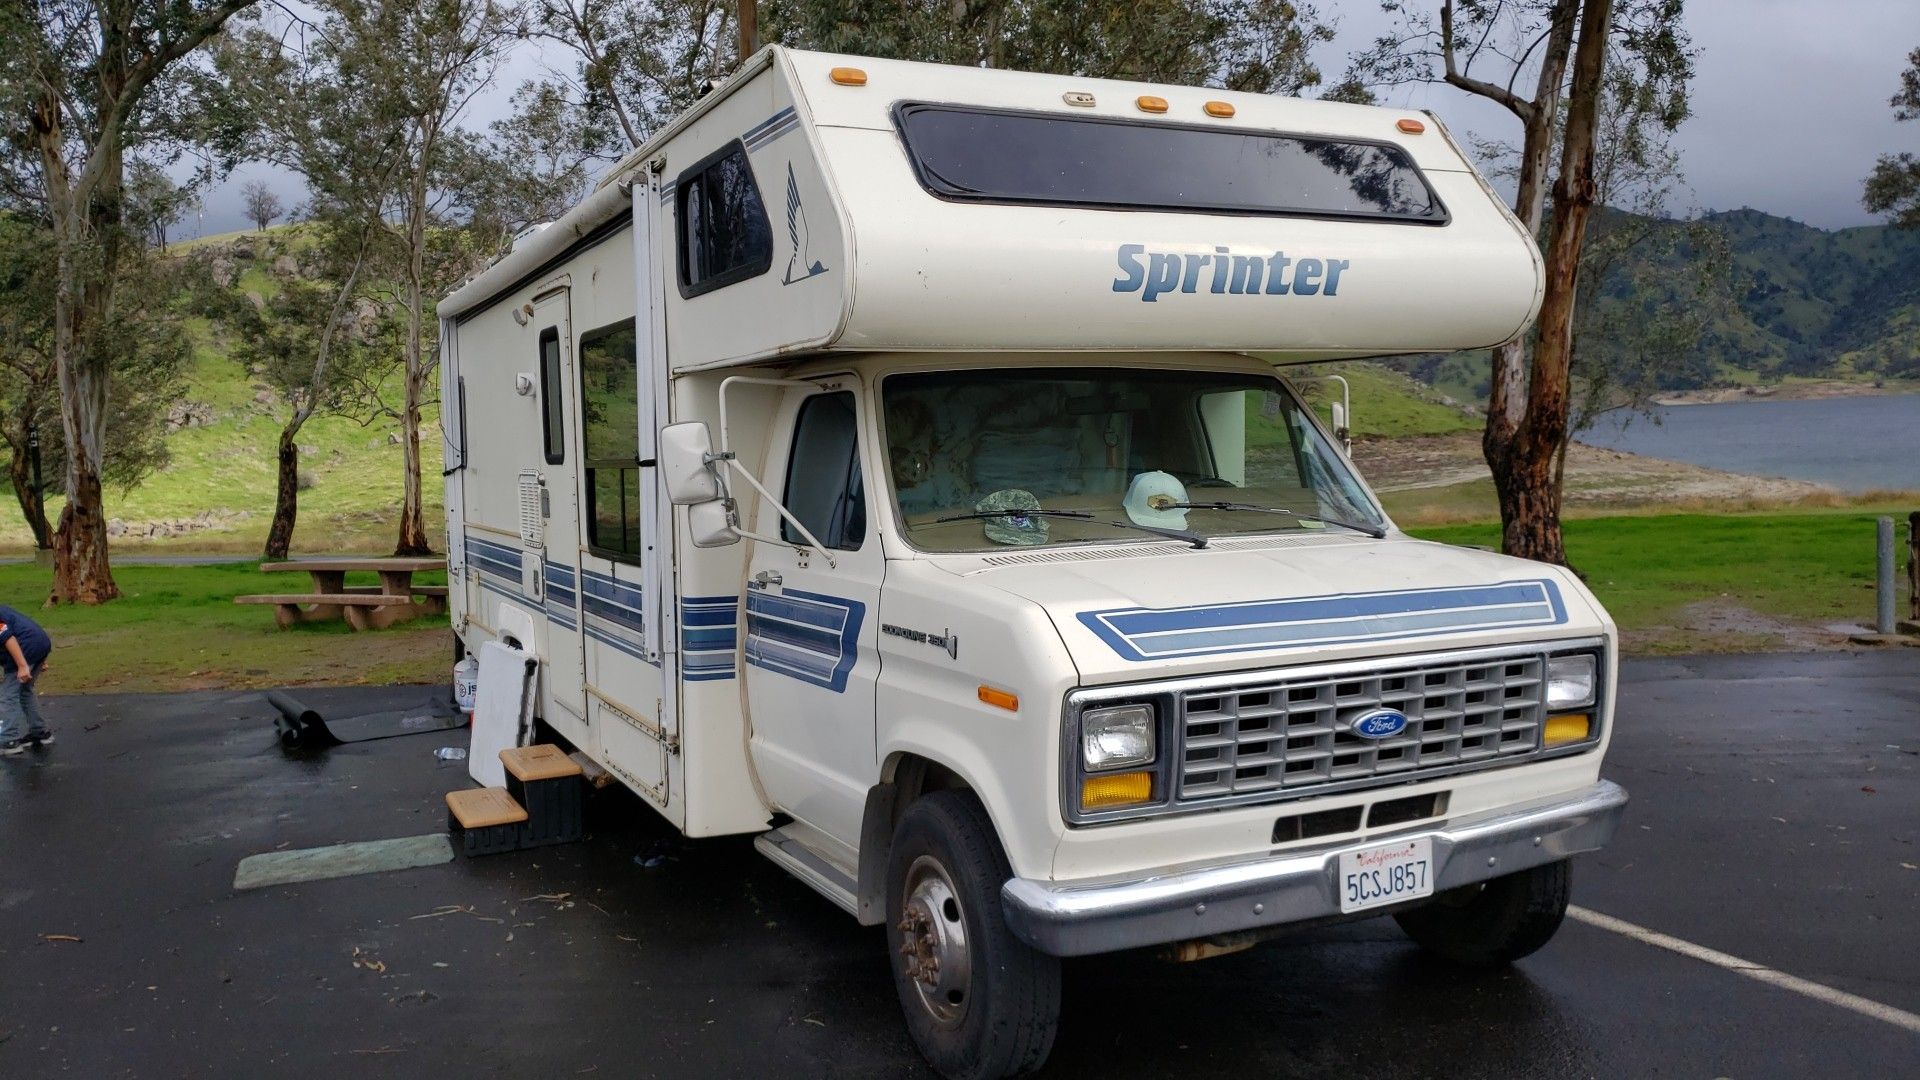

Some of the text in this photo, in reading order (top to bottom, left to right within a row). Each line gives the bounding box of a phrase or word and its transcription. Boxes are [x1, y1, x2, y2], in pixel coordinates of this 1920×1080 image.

[1112, 243, 1350, 302] Sprinter
[1368, 715, 1397, 733] Ford
[1358, 847, 1414, 866] California
[1347, 860, 1427, 903] 5CSJ857
